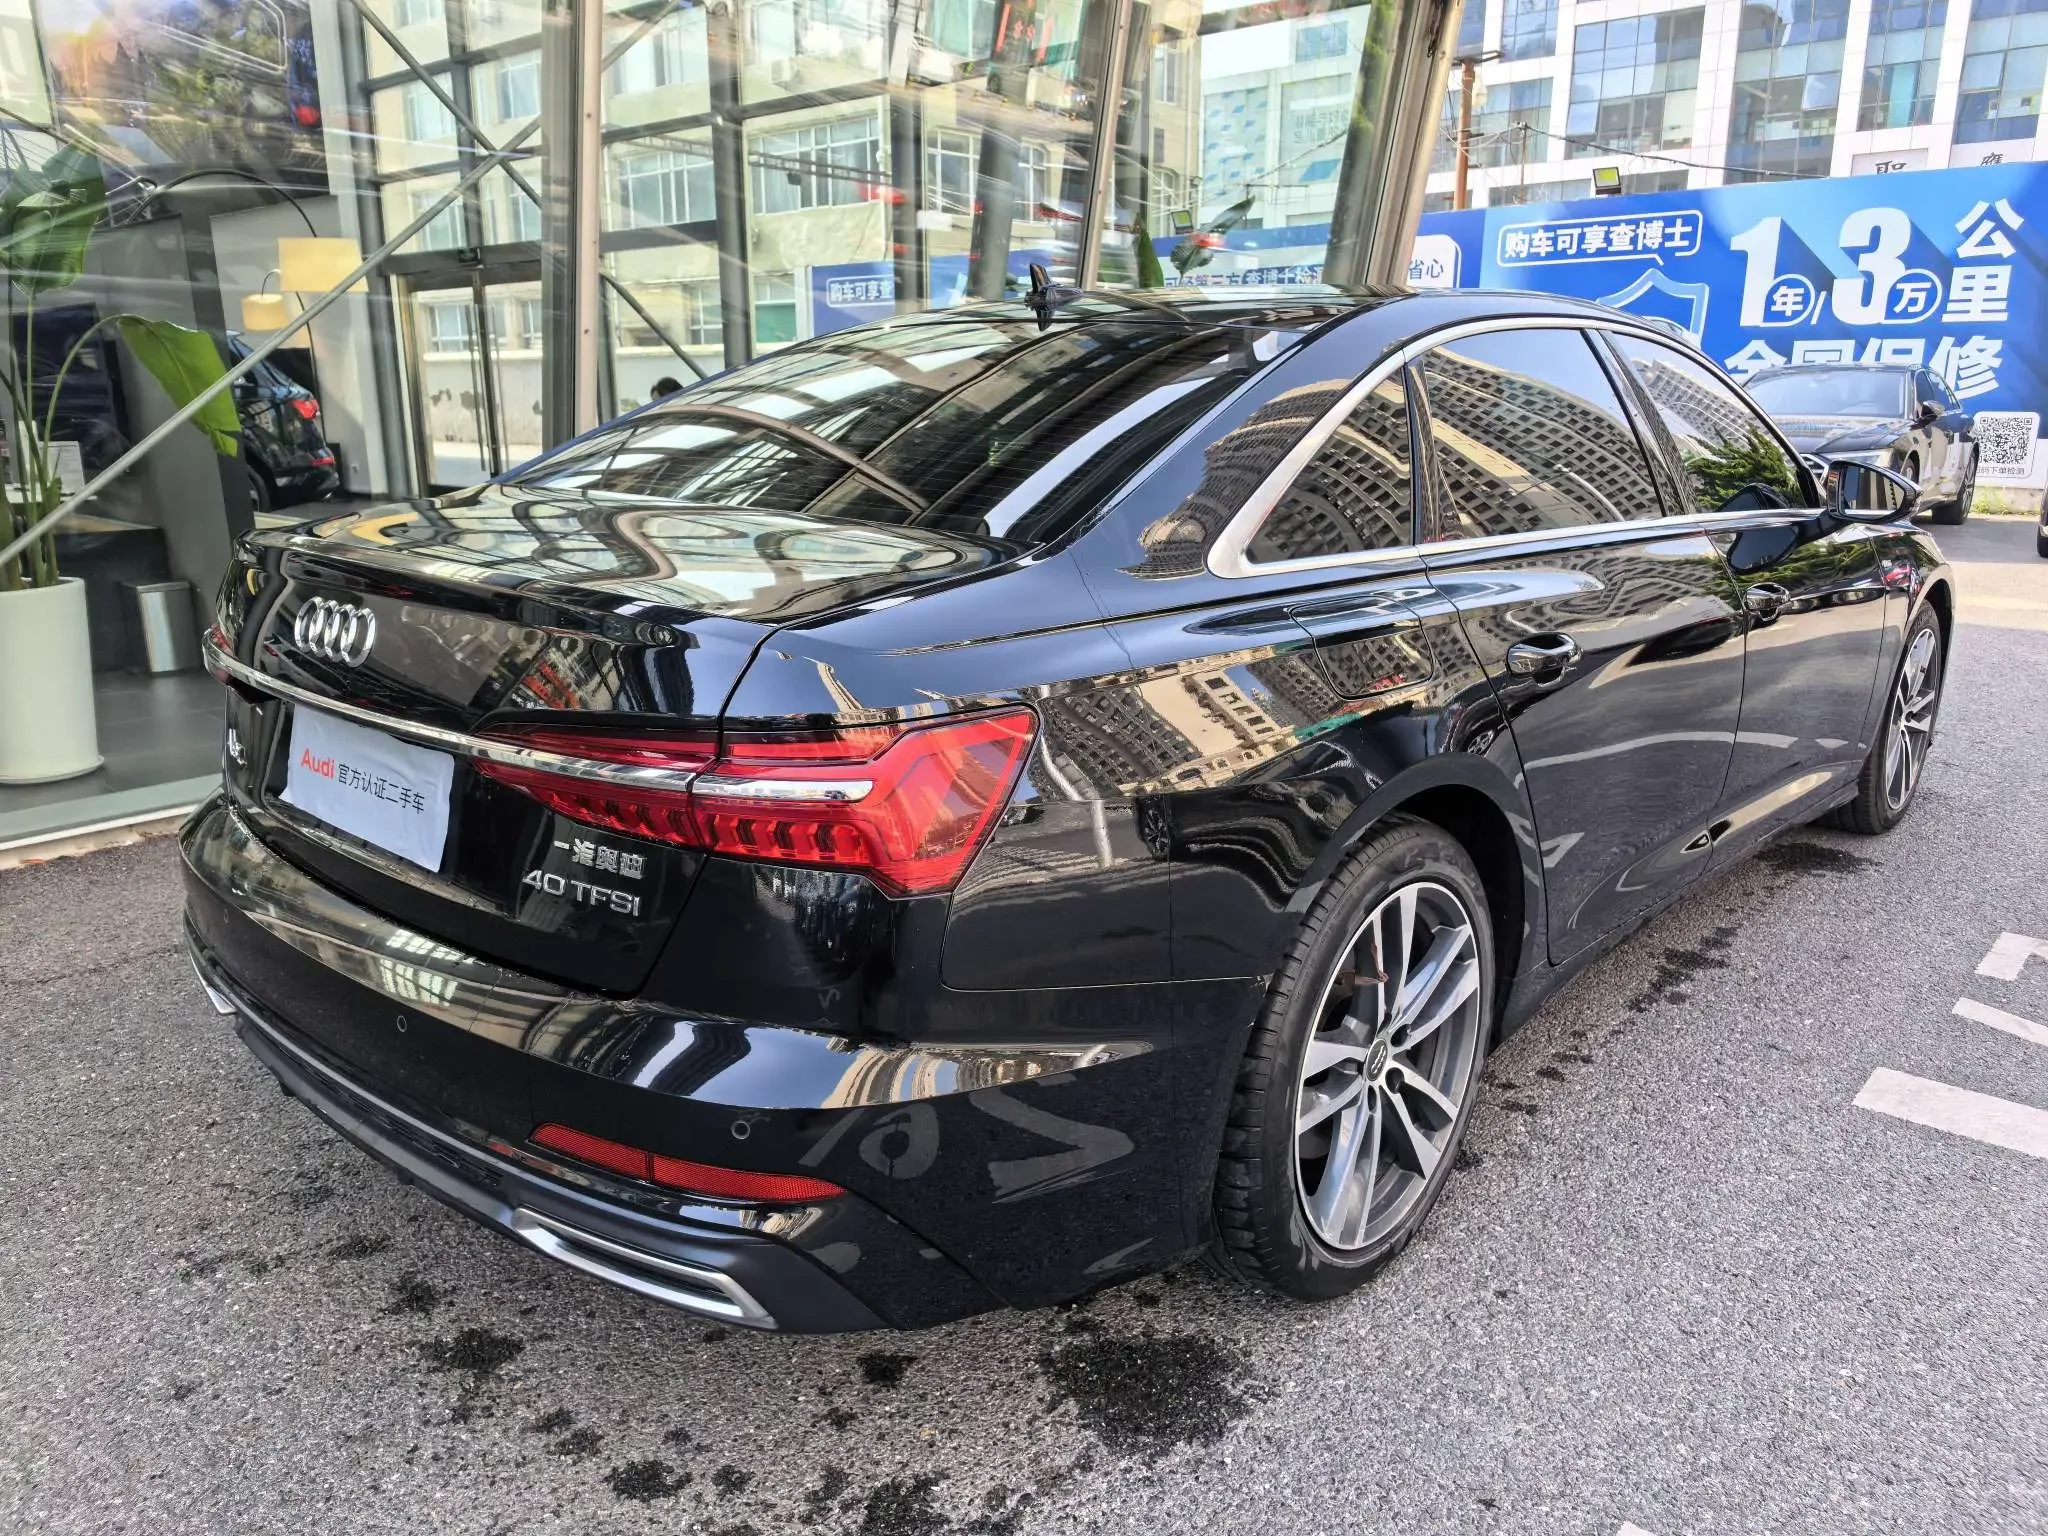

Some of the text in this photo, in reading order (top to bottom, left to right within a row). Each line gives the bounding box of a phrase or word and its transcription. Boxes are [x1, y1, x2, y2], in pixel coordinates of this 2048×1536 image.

[1504, 217, 1693, 259] 购车可享查博士
[1408, 258, 1444, 280] 省心
[301, 747, 425, 814] Audi 官方认证二手车
[522, 869, 640, 917] 40 TFSI
